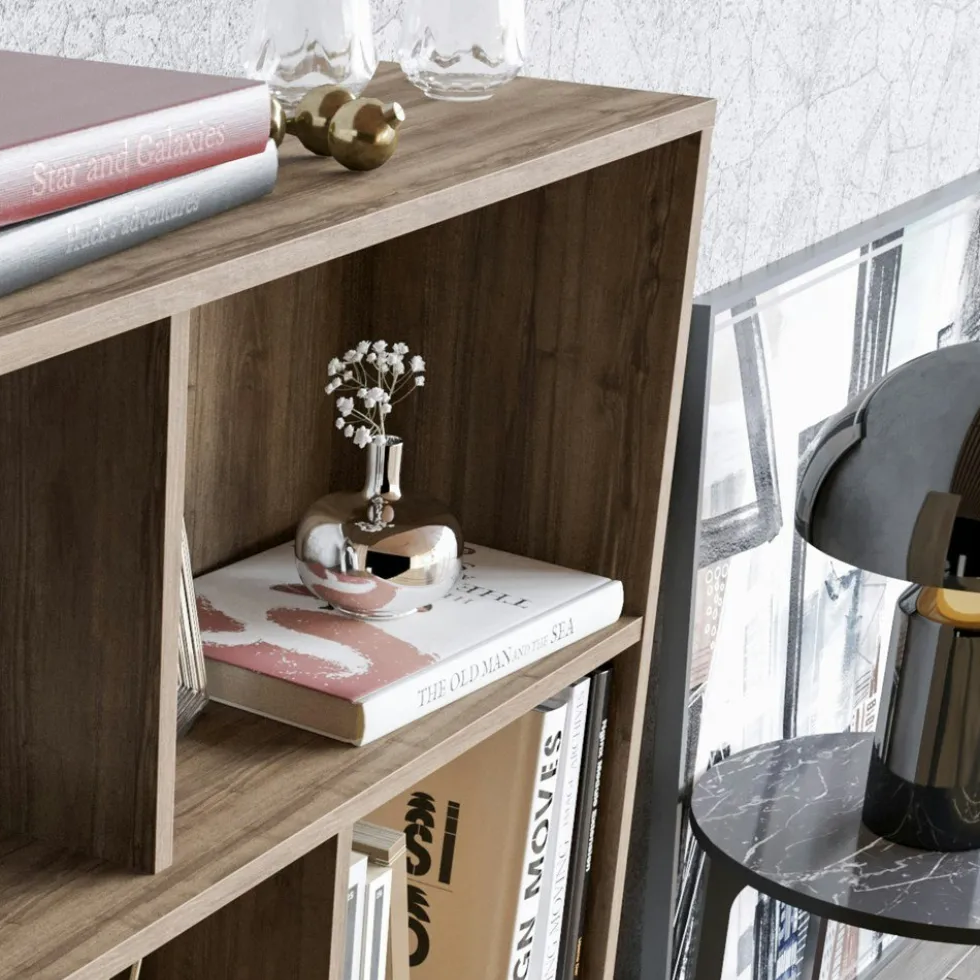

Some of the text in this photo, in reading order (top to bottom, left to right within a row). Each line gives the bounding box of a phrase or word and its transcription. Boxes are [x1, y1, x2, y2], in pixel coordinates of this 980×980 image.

[31, 120, 226, 197] Star and Galaxies
[417, 679, 447, 708] THE
[449, 663, 481, 692] OLD
[482, 647, 512, 677] MAN
[550, 617, 575, 644] SEA
[523, 730, 562, 900] MOVES
